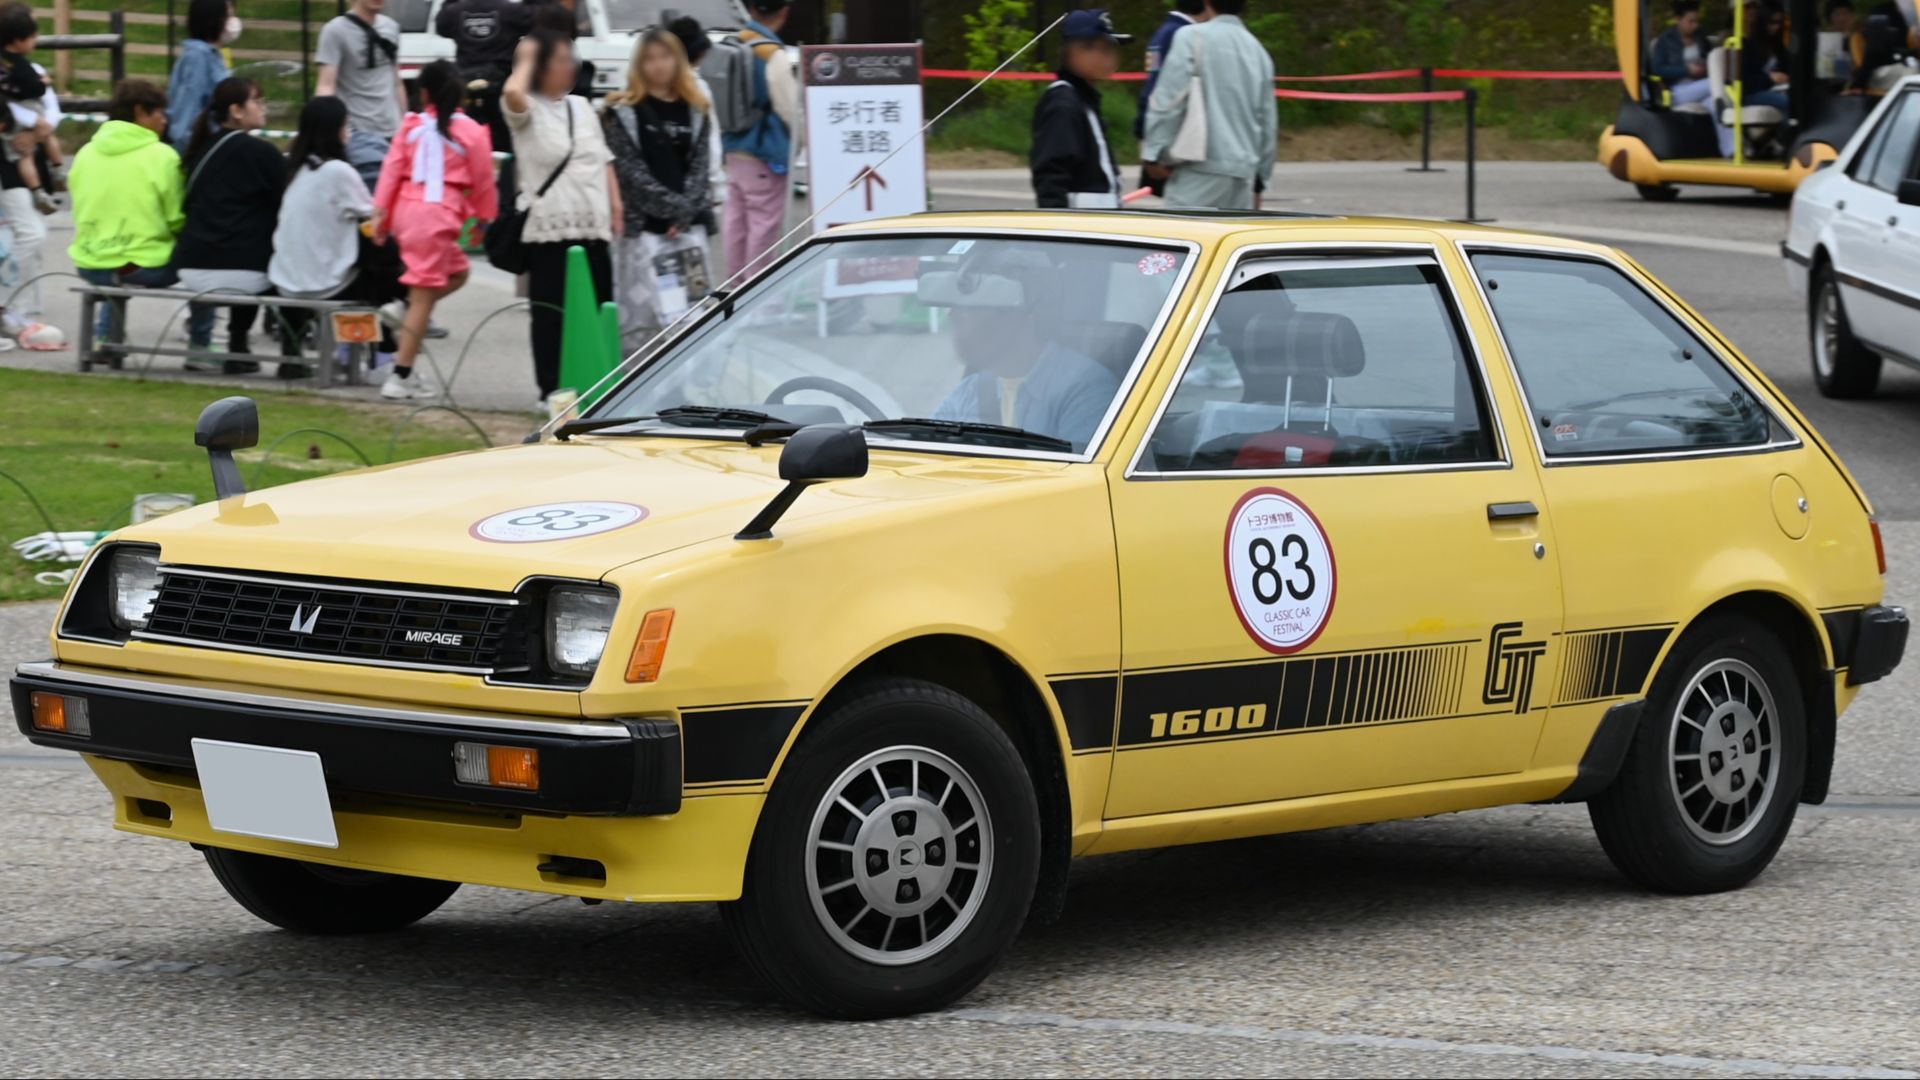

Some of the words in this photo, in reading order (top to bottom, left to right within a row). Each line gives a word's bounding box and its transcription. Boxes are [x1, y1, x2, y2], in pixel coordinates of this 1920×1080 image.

[828, 100, 901, 124] 歩行者
[842, 130, 890, 153] 通路
[507, 509, 611, 531] 83
[1248, 511, 1295, 527] トヨタ博物館
[1248, 533, 1316, 605] 83
[1264, 609, 1294, 623] CLASSIC
[1295, 606, 1312, 619] CAR
[405, 630, 463, 646] MIRAGE
[1273, 622, 1304, 635] FESTIVAL
[1482, 621, 1547, 715] GT
[1150, 703, 1267, 738] 1600
